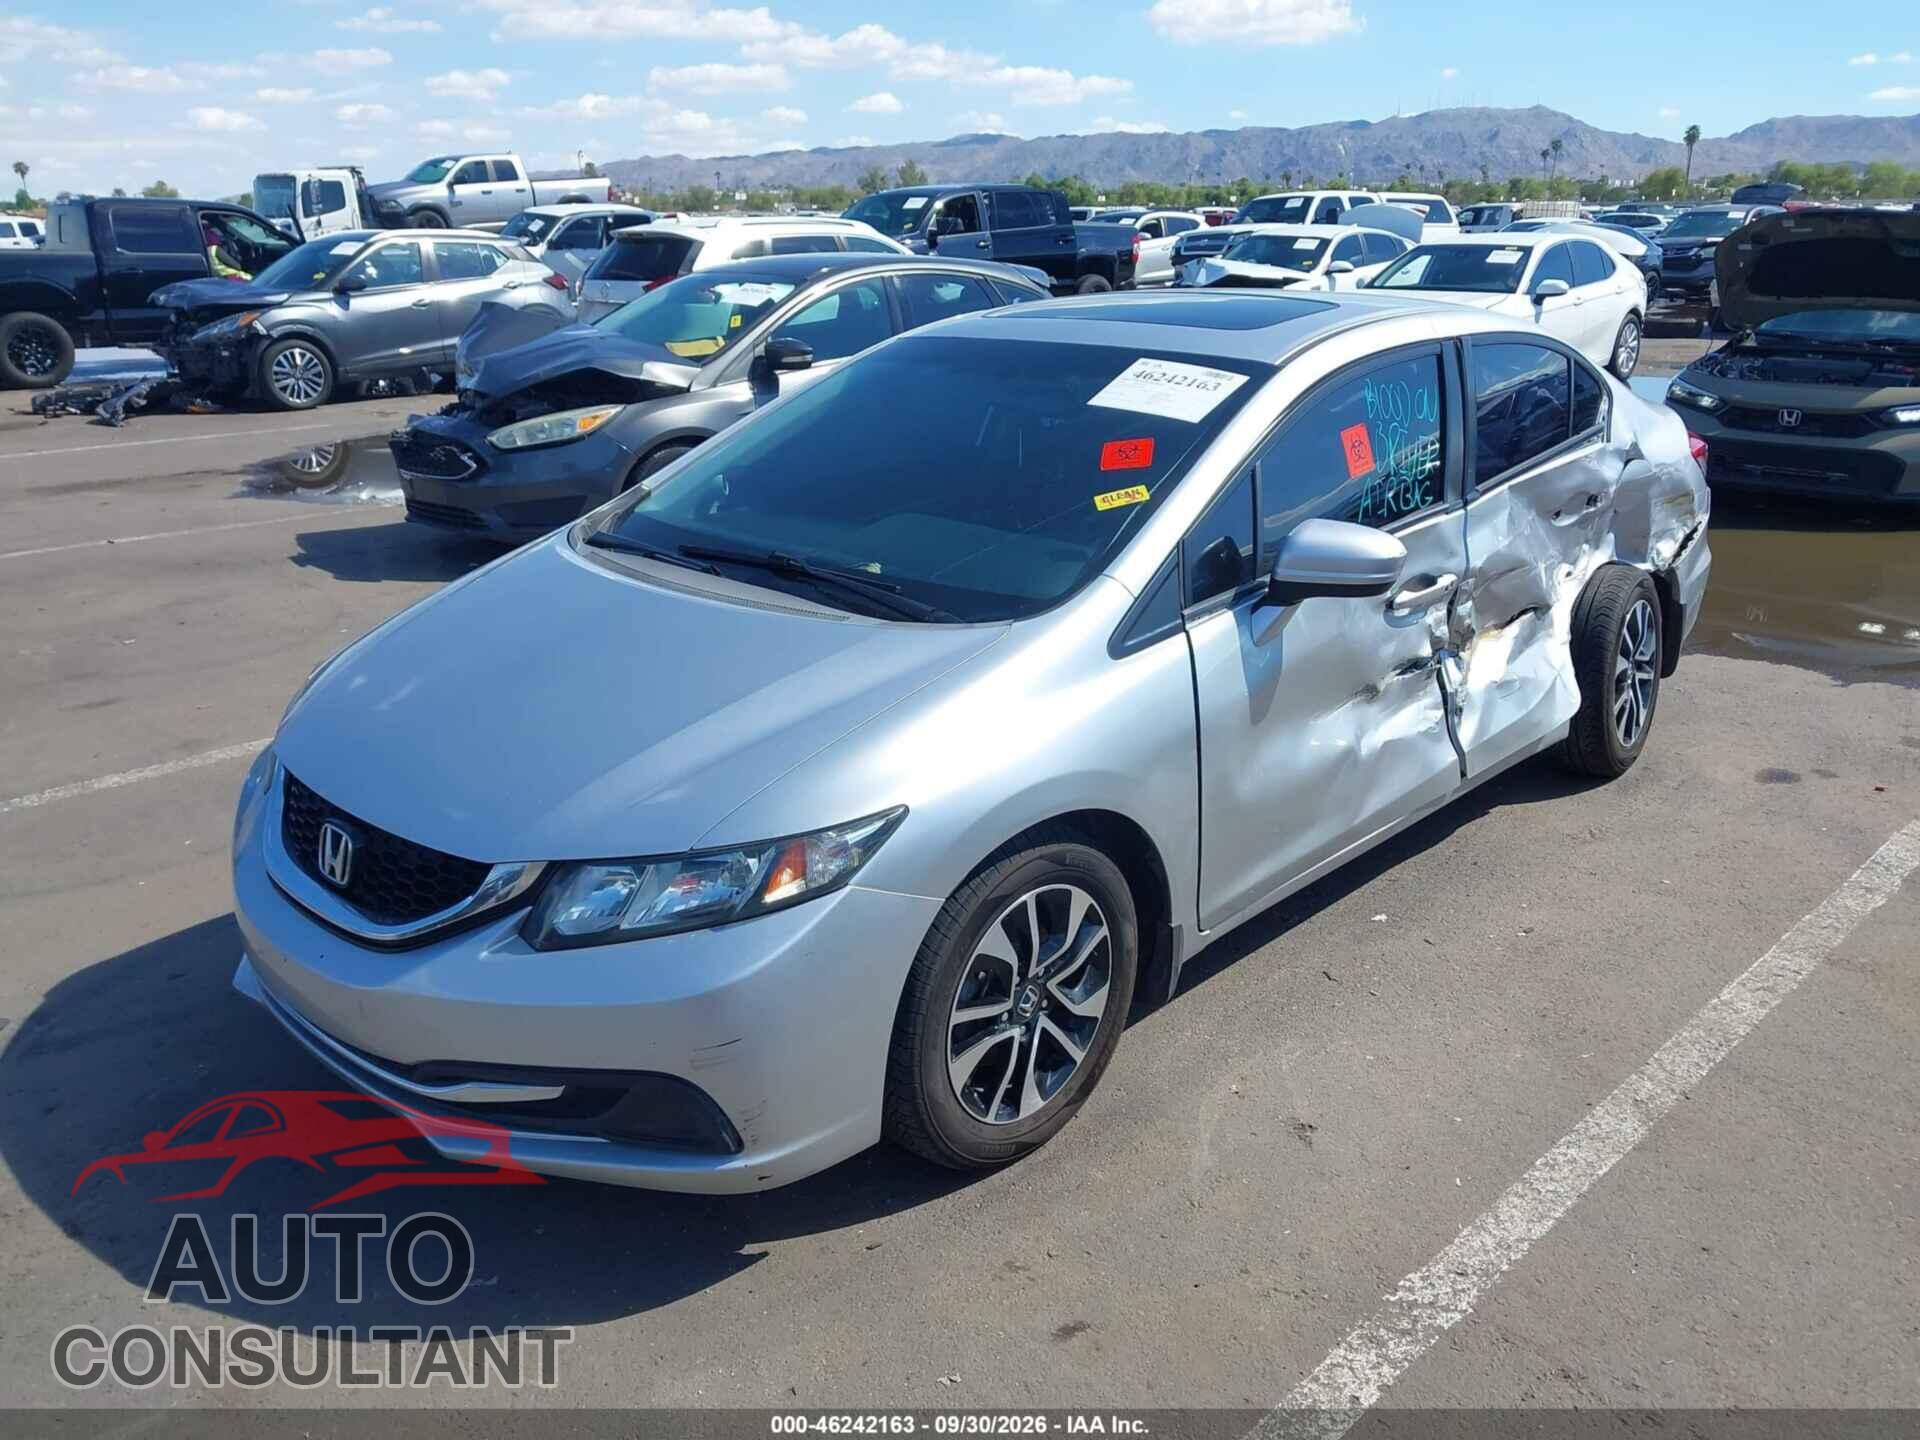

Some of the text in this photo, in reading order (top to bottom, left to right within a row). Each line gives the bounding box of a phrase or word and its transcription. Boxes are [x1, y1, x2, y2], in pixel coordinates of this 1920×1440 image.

[1133, 369, 1222, 391] 46242163
[1415, 384, 1438, 422] ON
[1358, 476, 1434, 522] AIRBAG
